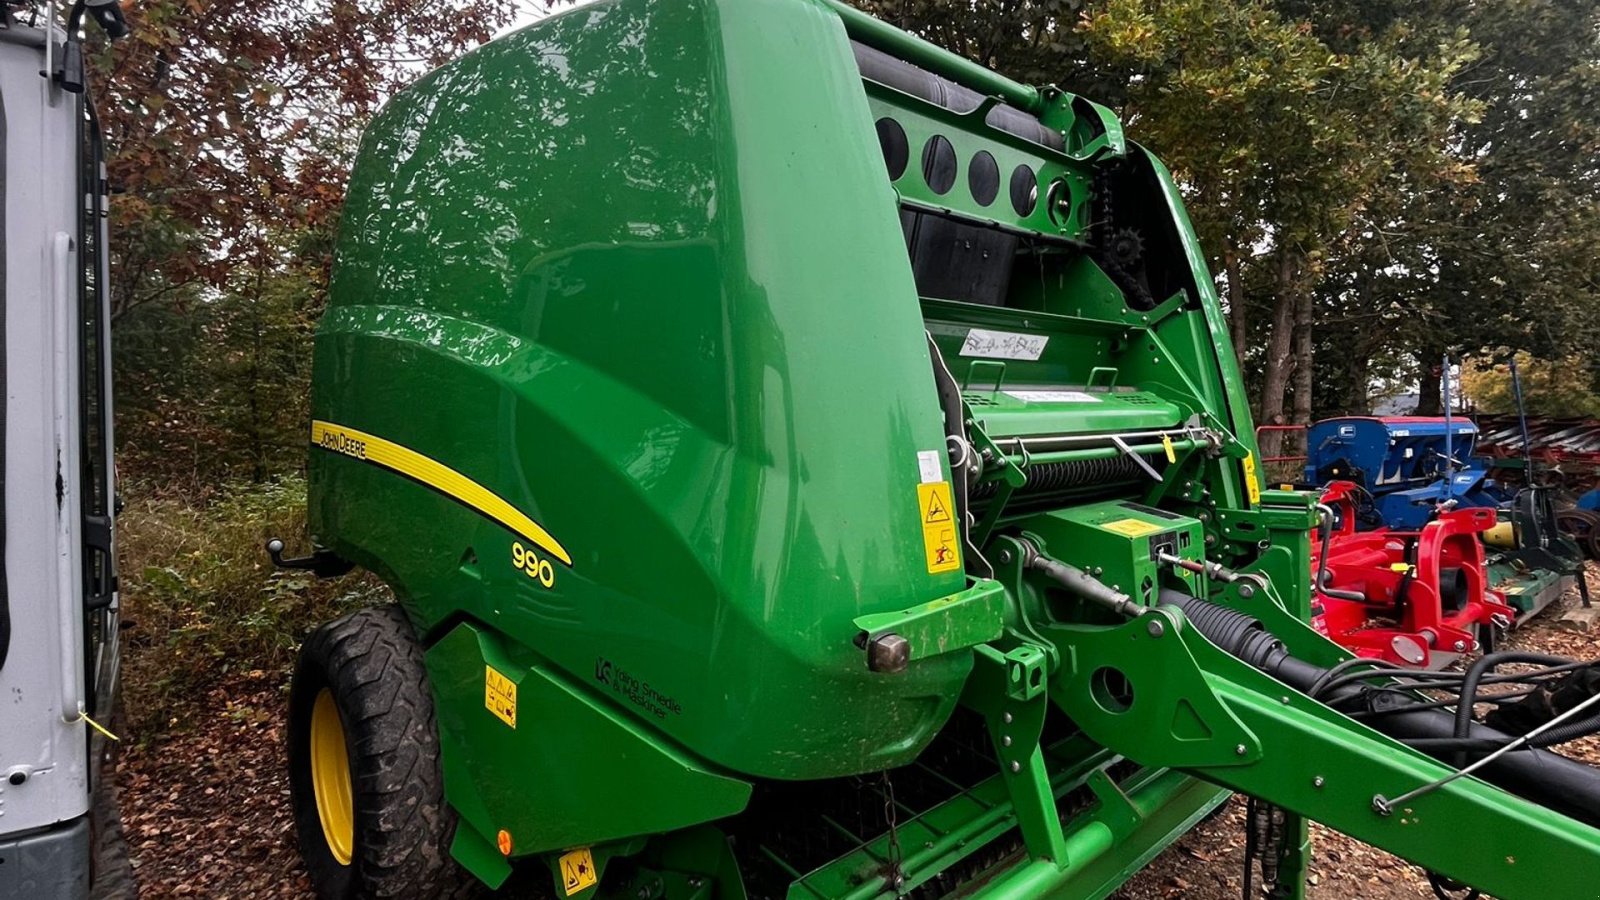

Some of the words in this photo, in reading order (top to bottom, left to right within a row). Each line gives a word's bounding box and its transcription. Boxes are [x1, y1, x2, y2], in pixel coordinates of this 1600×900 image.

[320, 429, 339, 451] JOHN
[339, 433, 366, 458] DEERE
[511, 541, 555, 589] 990
